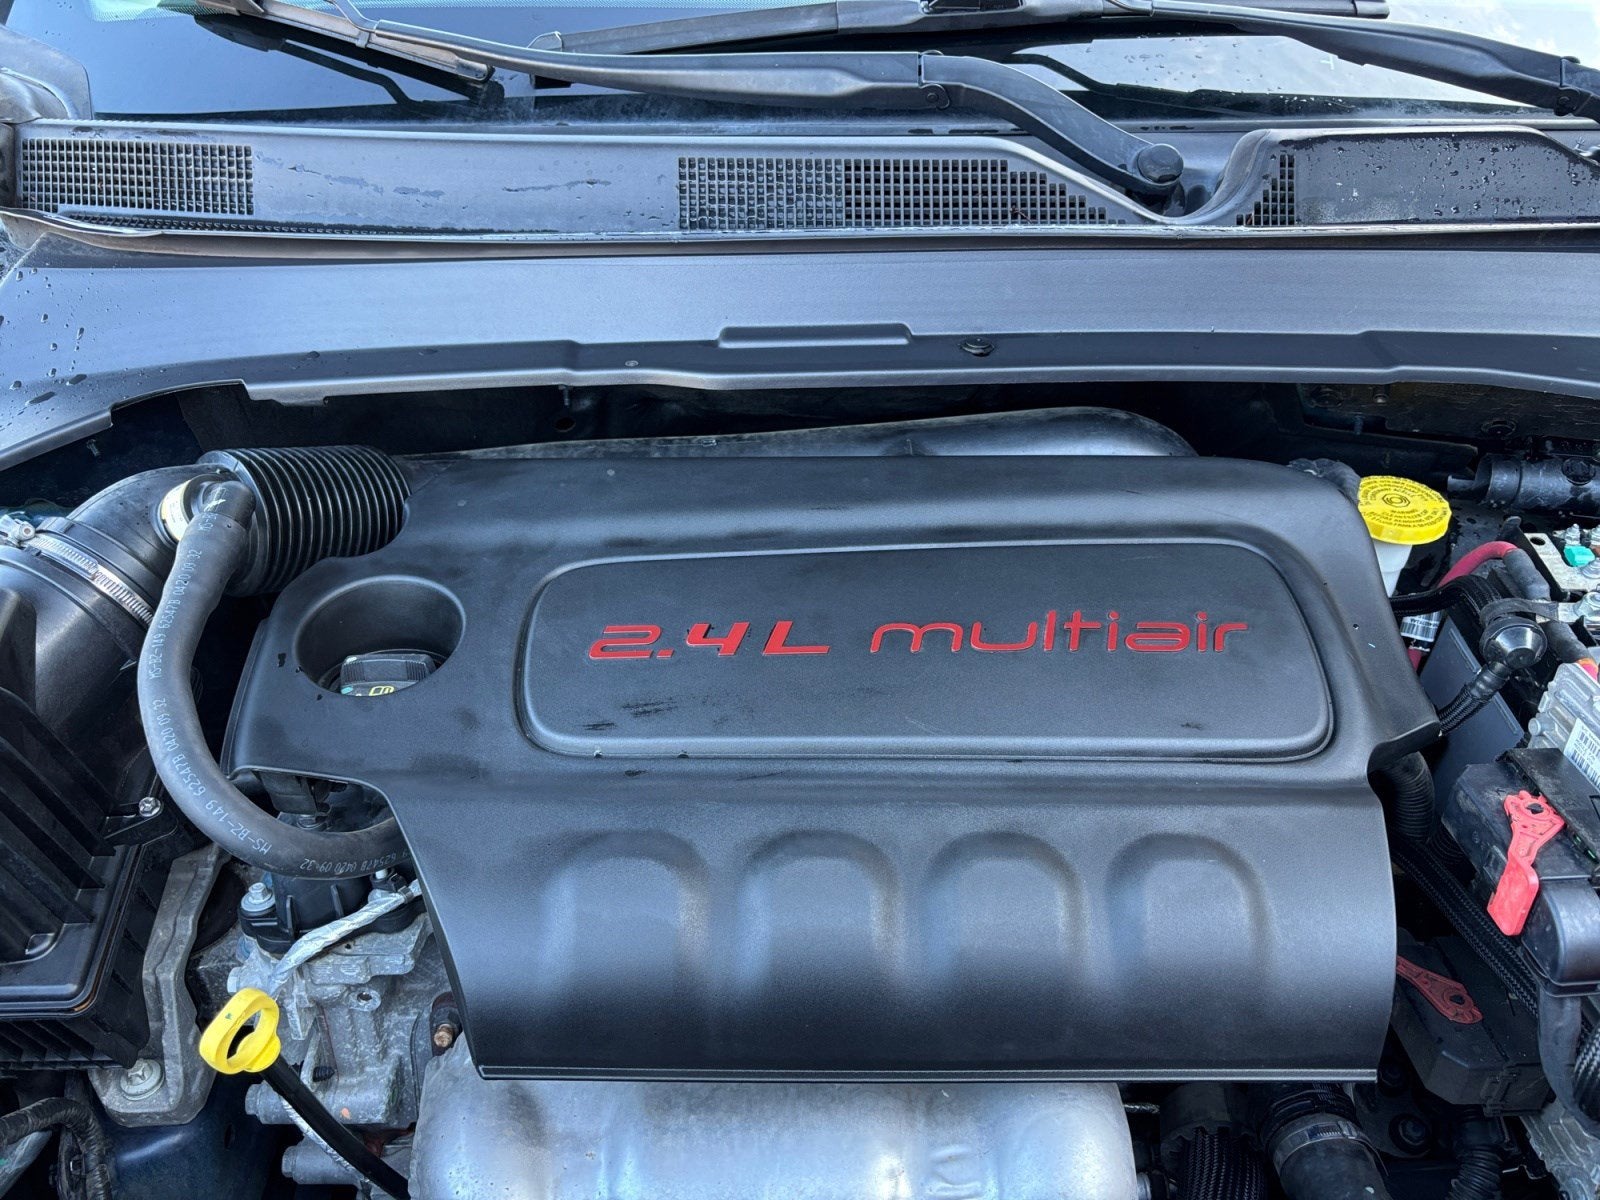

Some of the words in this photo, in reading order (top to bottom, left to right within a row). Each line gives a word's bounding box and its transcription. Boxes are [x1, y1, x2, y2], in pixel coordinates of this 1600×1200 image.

[869, 609, 1249, 653] multiair
[160, 727, 180, 752] 0420
[172, 754, 207, 797] 62547B
[204, 799, 273, 855] MS-BZ-149
